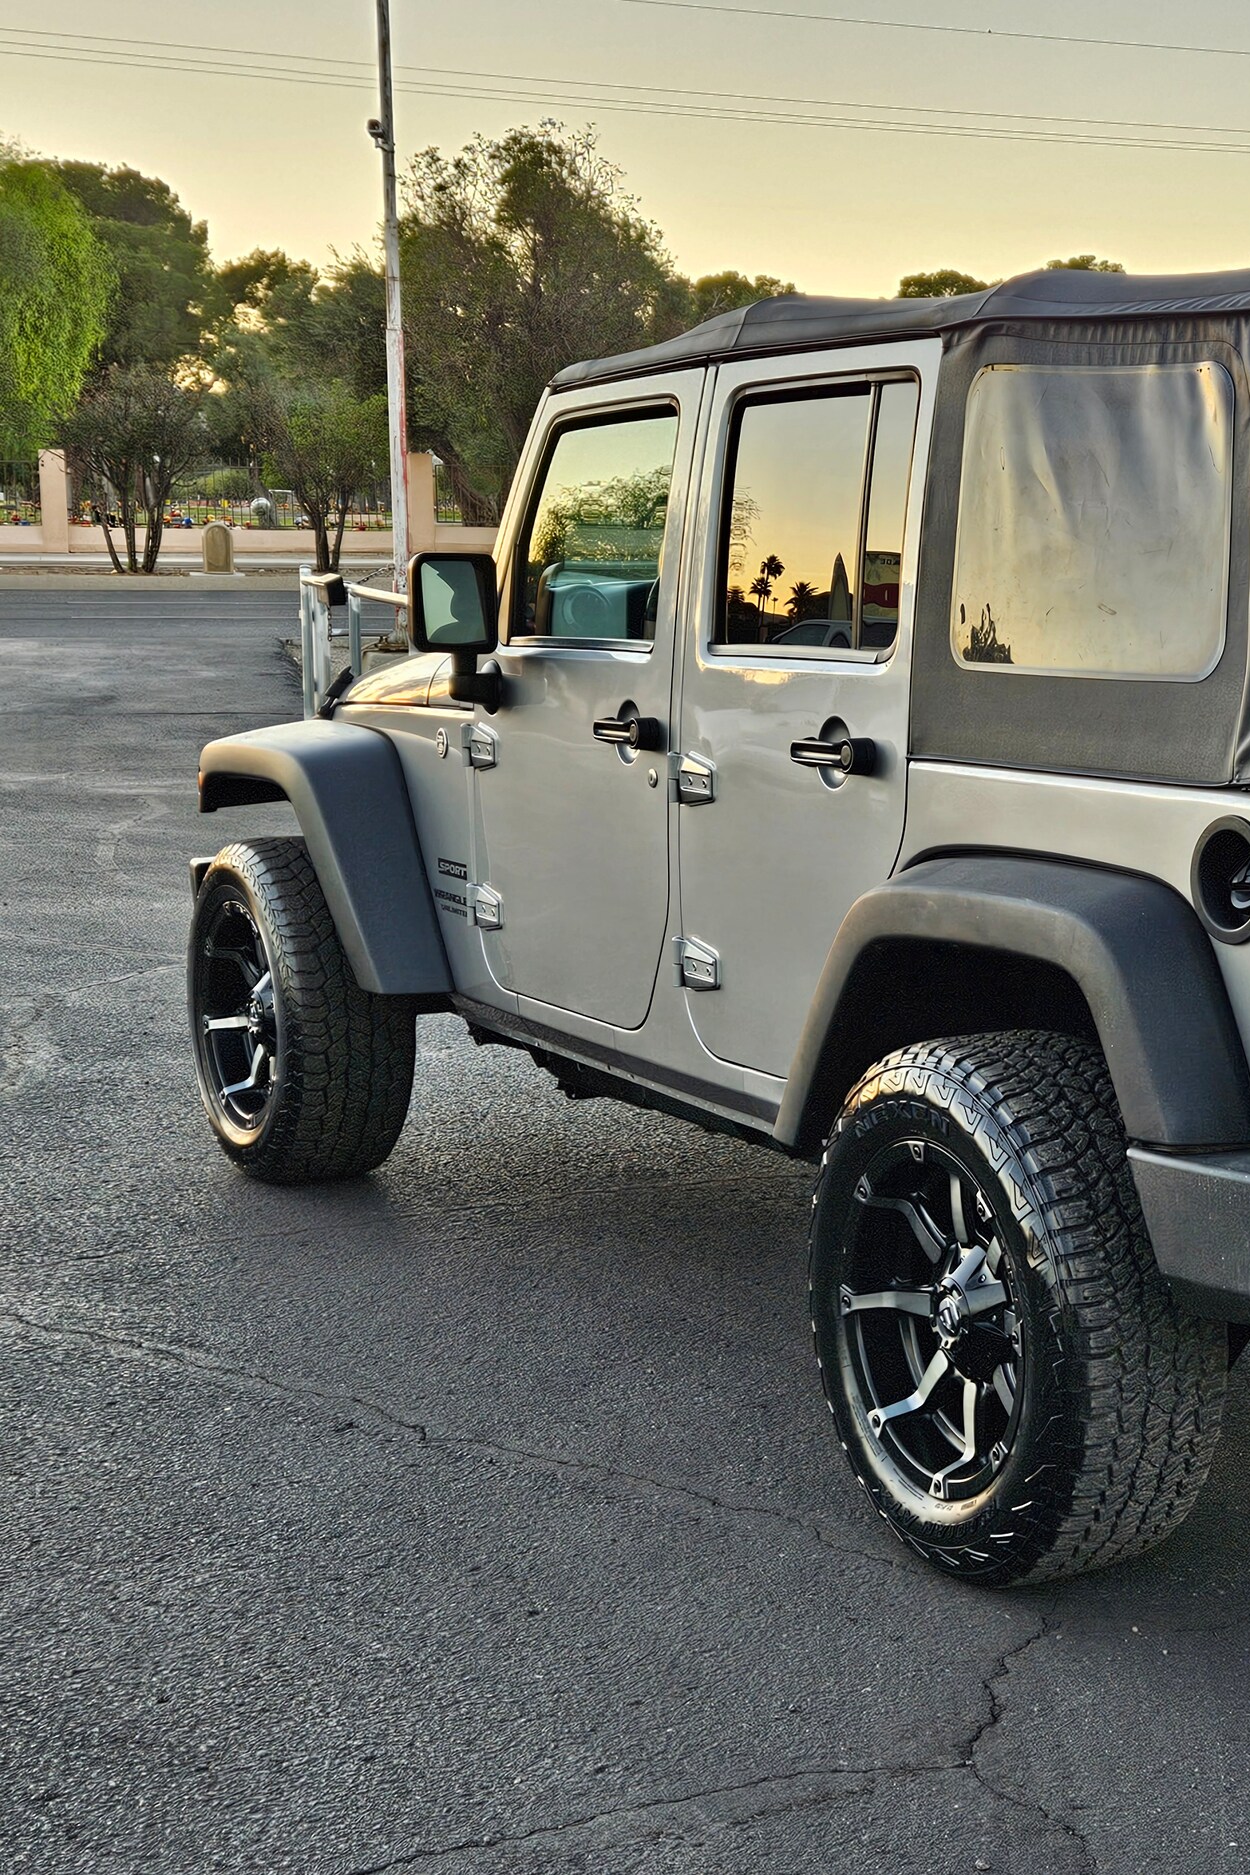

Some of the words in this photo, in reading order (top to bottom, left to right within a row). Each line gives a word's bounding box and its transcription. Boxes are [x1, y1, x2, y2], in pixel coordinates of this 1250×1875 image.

[439, 862, 466, 877] SPORT
[434, 888, 467, 907] WRANGLE
[854, 1100, 950, 1138] NEXEN
